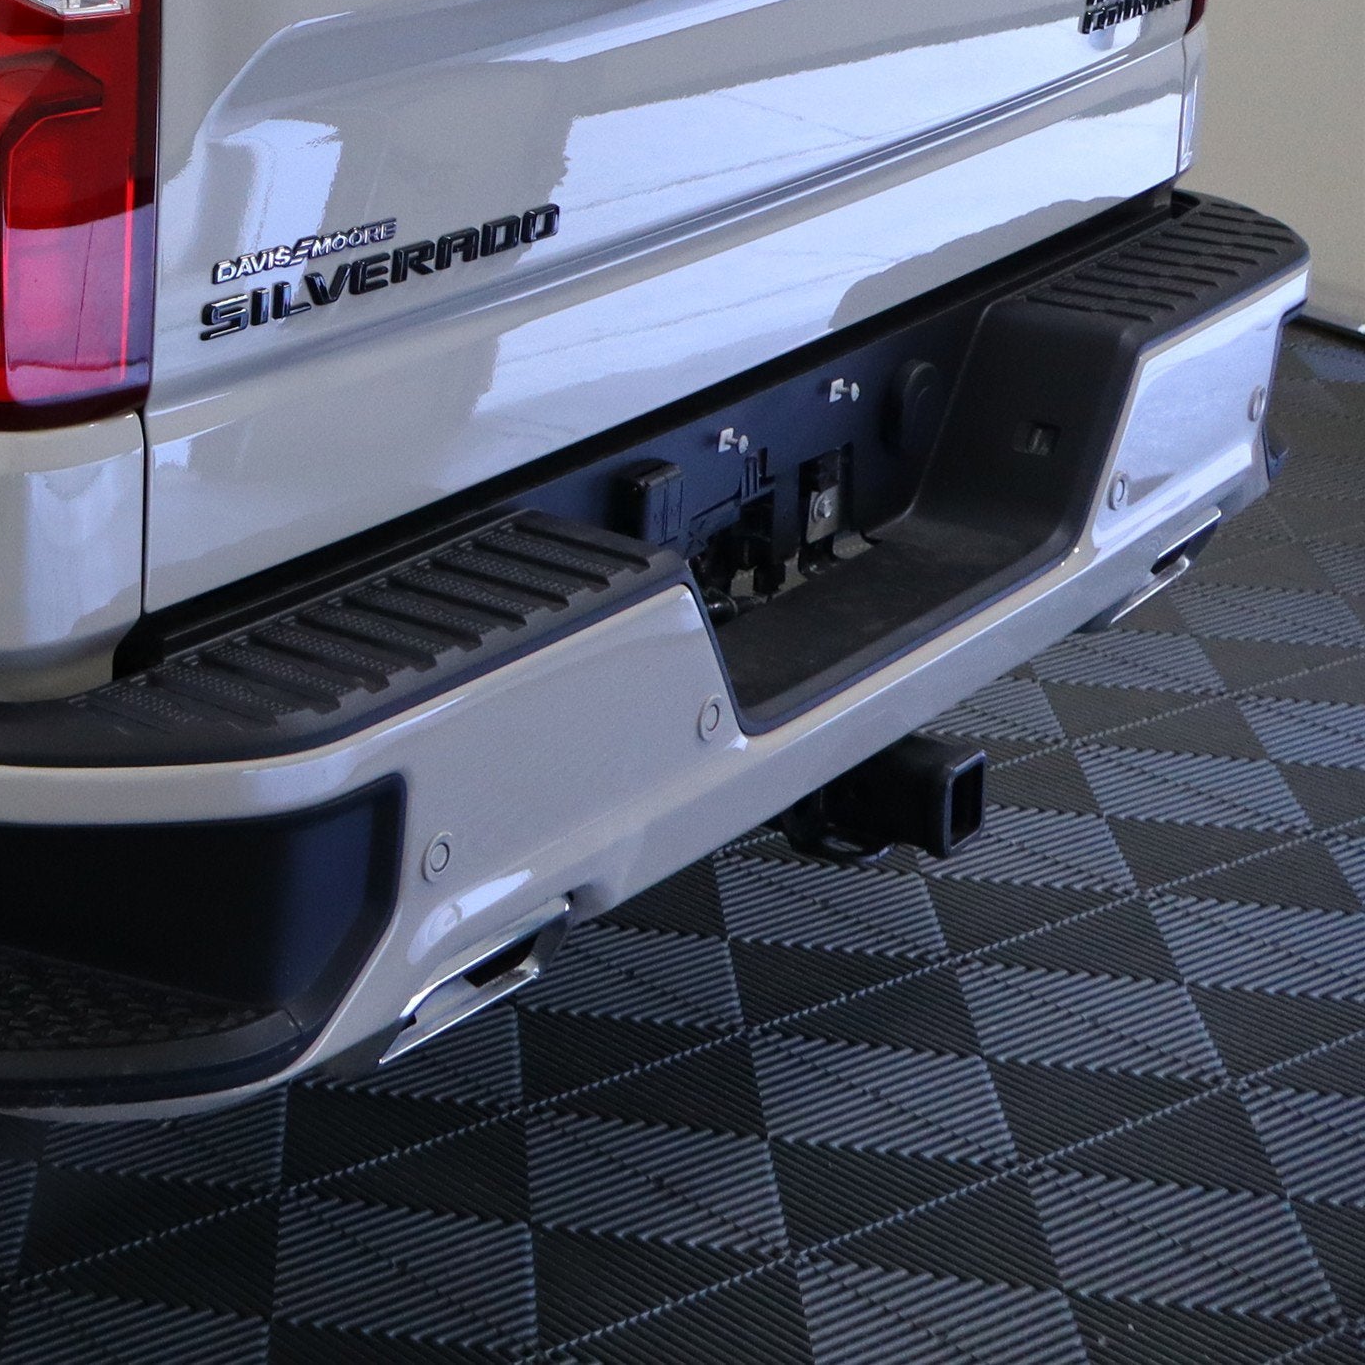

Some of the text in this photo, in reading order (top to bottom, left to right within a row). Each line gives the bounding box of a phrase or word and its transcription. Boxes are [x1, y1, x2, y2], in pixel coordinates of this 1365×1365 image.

[200, 203, 561, 341] SILVERADO
[212, 217, 397, 285] DAVIS MOORE
